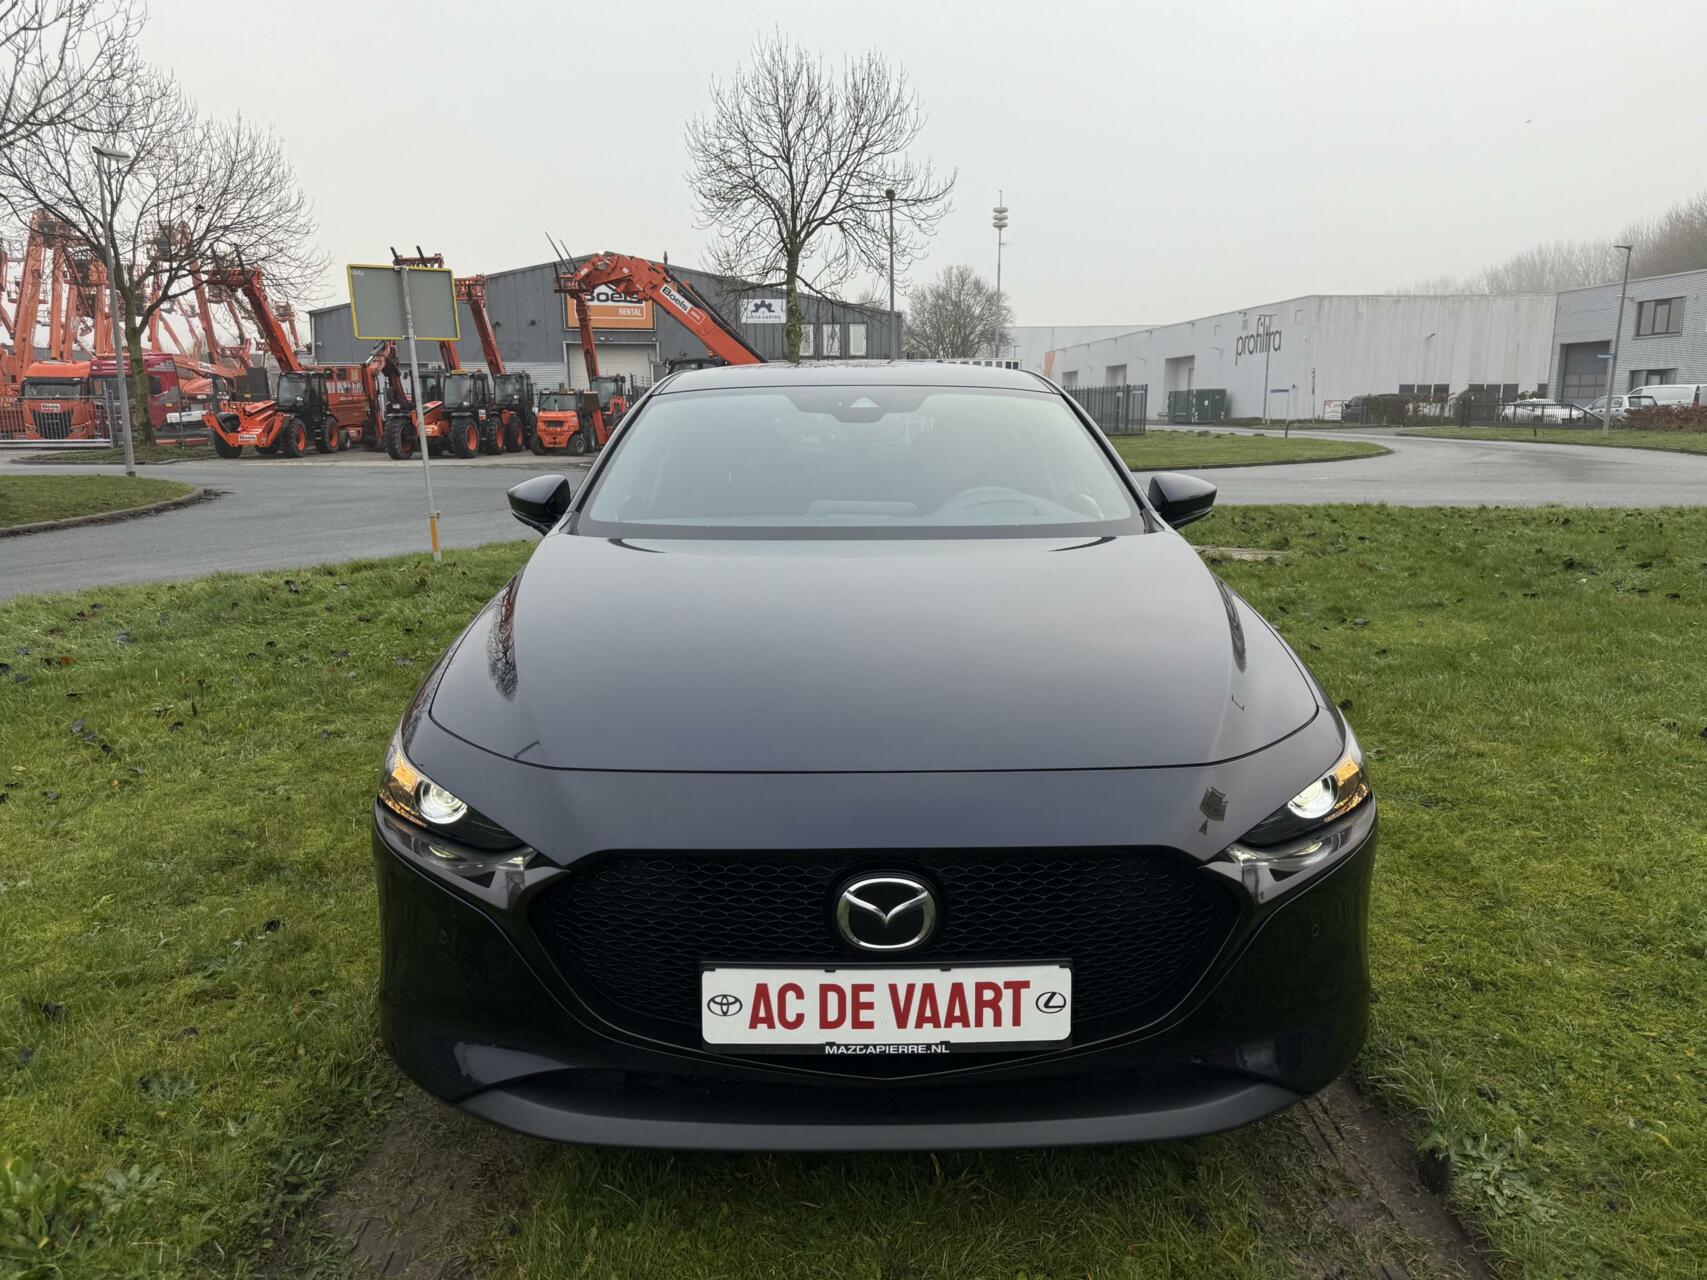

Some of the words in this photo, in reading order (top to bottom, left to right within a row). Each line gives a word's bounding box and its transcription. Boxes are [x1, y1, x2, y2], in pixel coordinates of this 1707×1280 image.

[662, 286, 689, 311] Boels
[618, 308, 642, 316] RENTAL
[1235, 317, 1281, 366] profiltra
[748, 982, 805, 1030] AC
[818, 983, 875, 1030] DE
[888, 980, 1031, 1030] VAART
[825, 1044, 950, 1055] MAZDAPIERRE.NL
